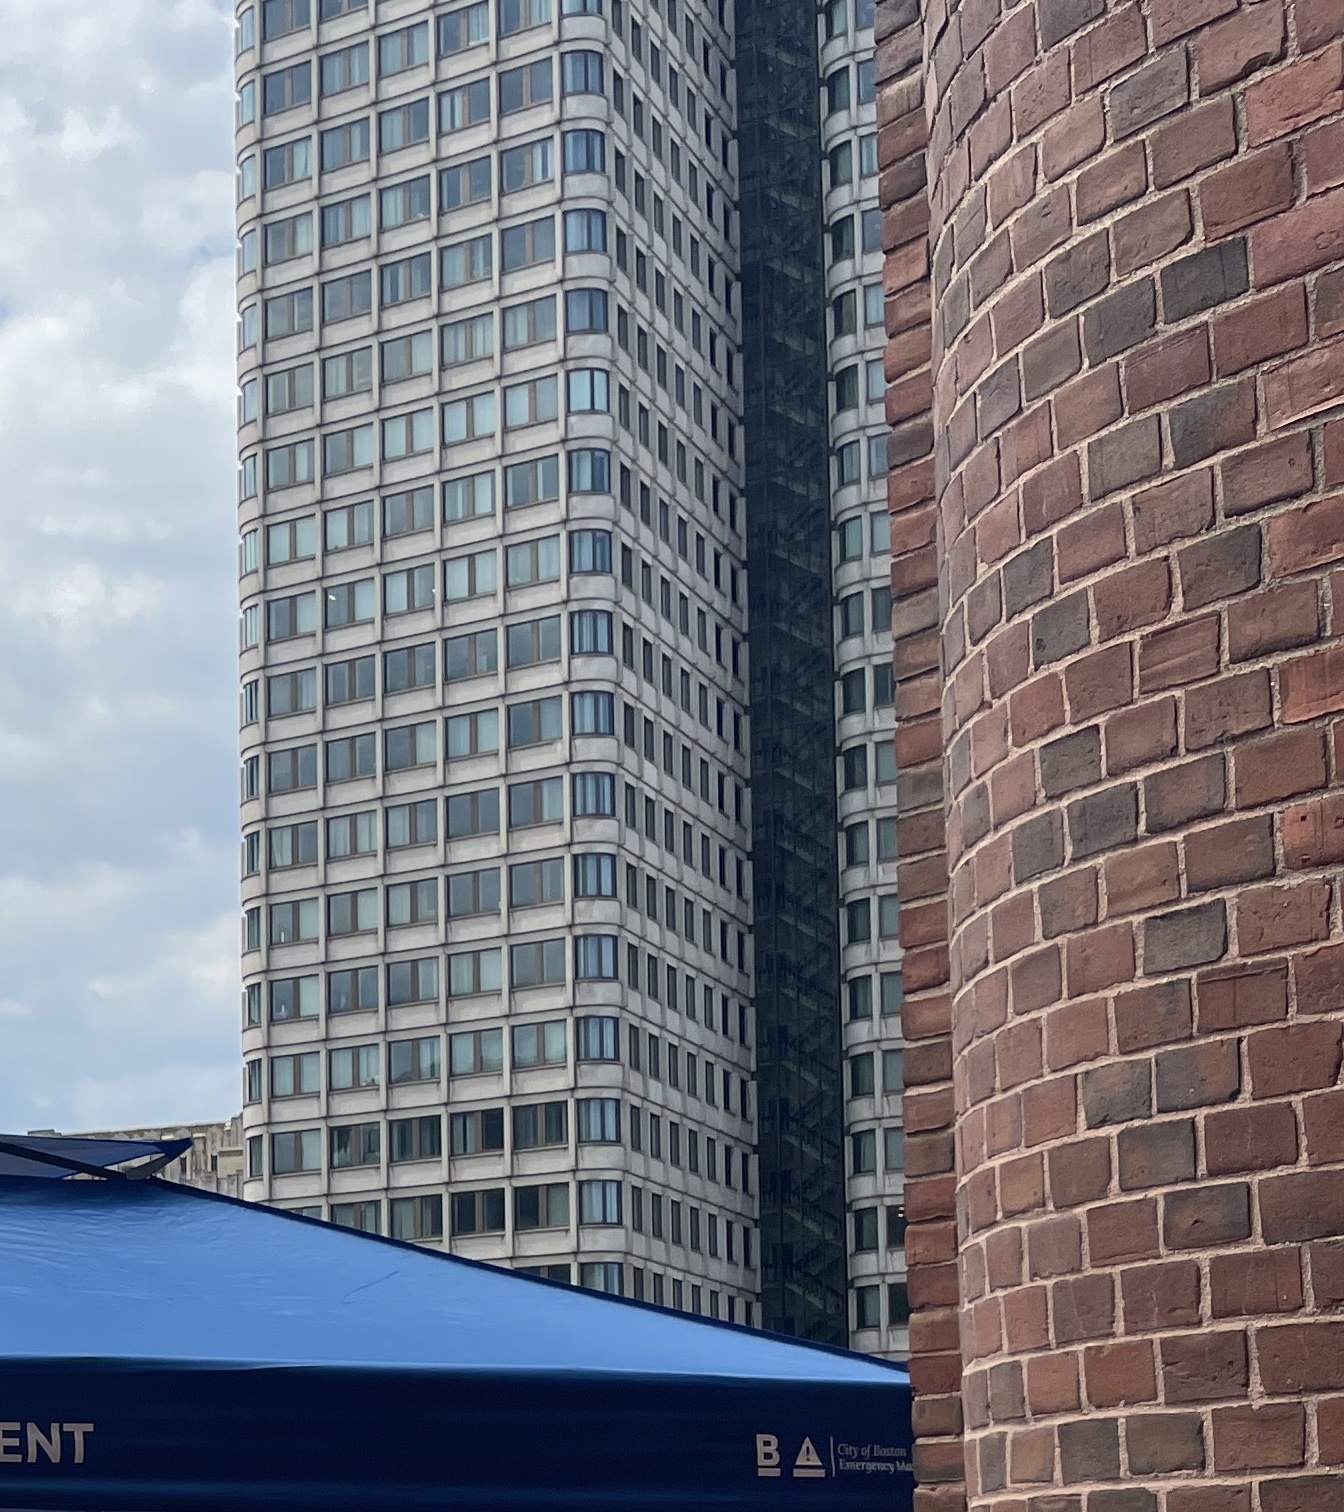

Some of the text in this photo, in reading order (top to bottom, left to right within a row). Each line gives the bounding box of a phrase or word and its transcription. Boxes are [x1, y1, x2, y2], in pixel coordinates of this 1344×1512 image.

[755, 1433, 781, 1467] B
[837, 1443, 907, 1460] City of Boston
[839, 1459, 895, 1476] Emergency
